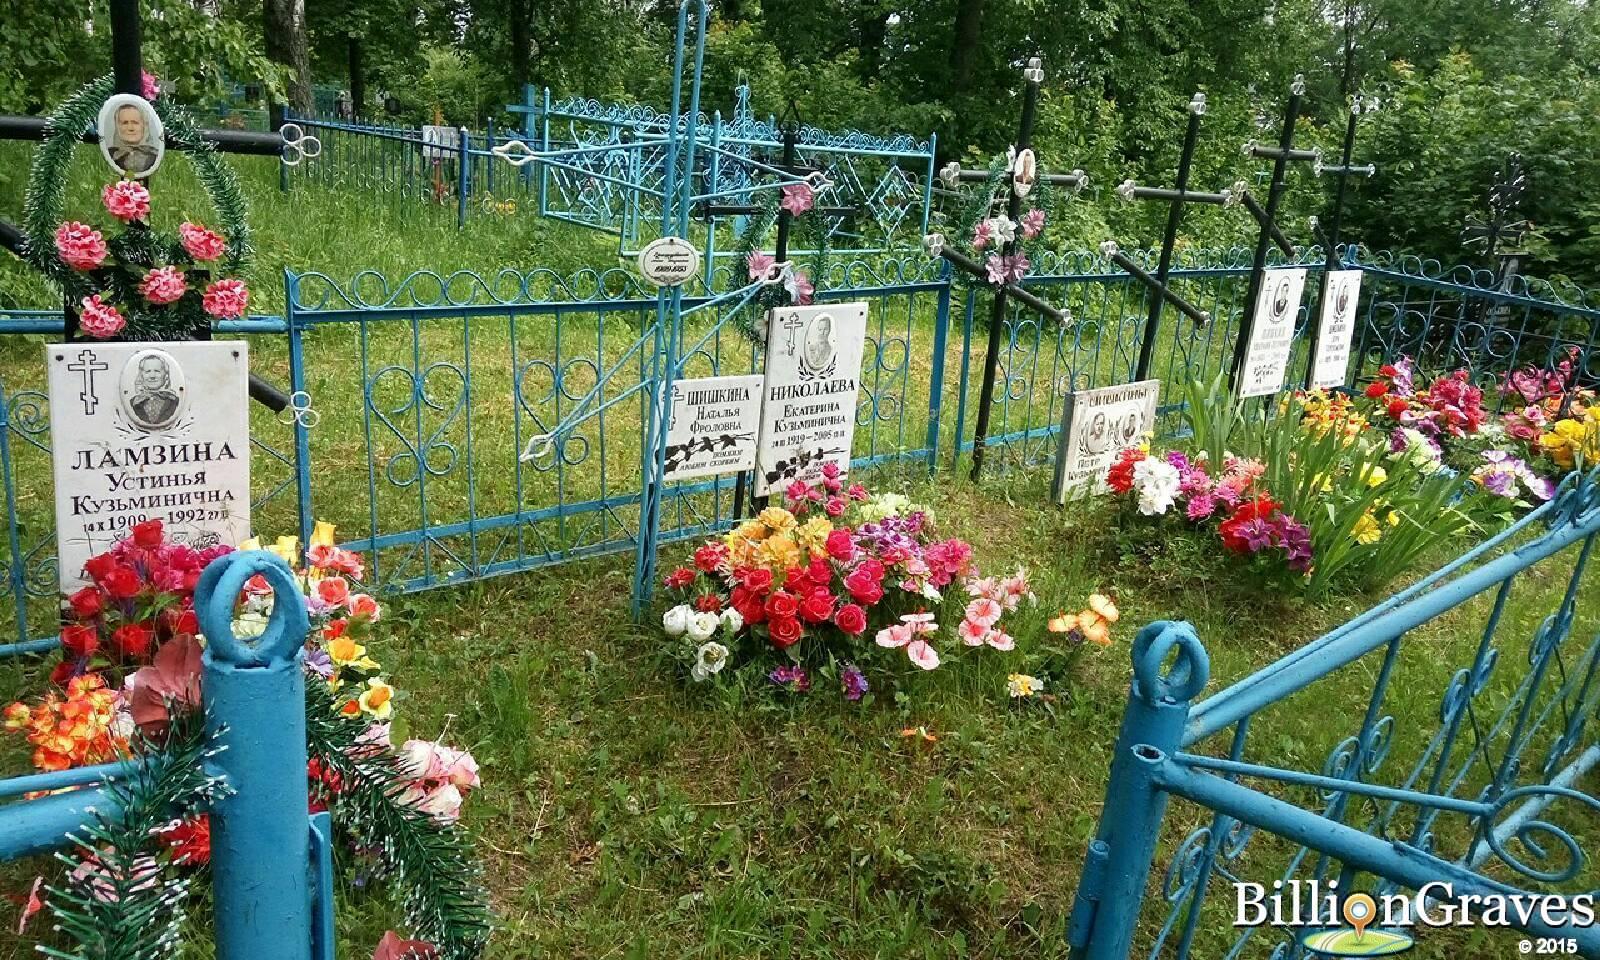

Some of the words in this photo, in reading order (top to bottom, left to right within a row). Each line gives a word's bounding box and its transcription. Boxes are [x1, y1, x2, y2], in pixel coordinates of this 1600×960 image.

[687, 387, 750, 406] ШИШКИНА
[770, 379, 855, 401] НИКОЛАЕВА
[70, 441, 239, 470] ЛАМЗИНА
[168, 509, 206, 525] 1992
